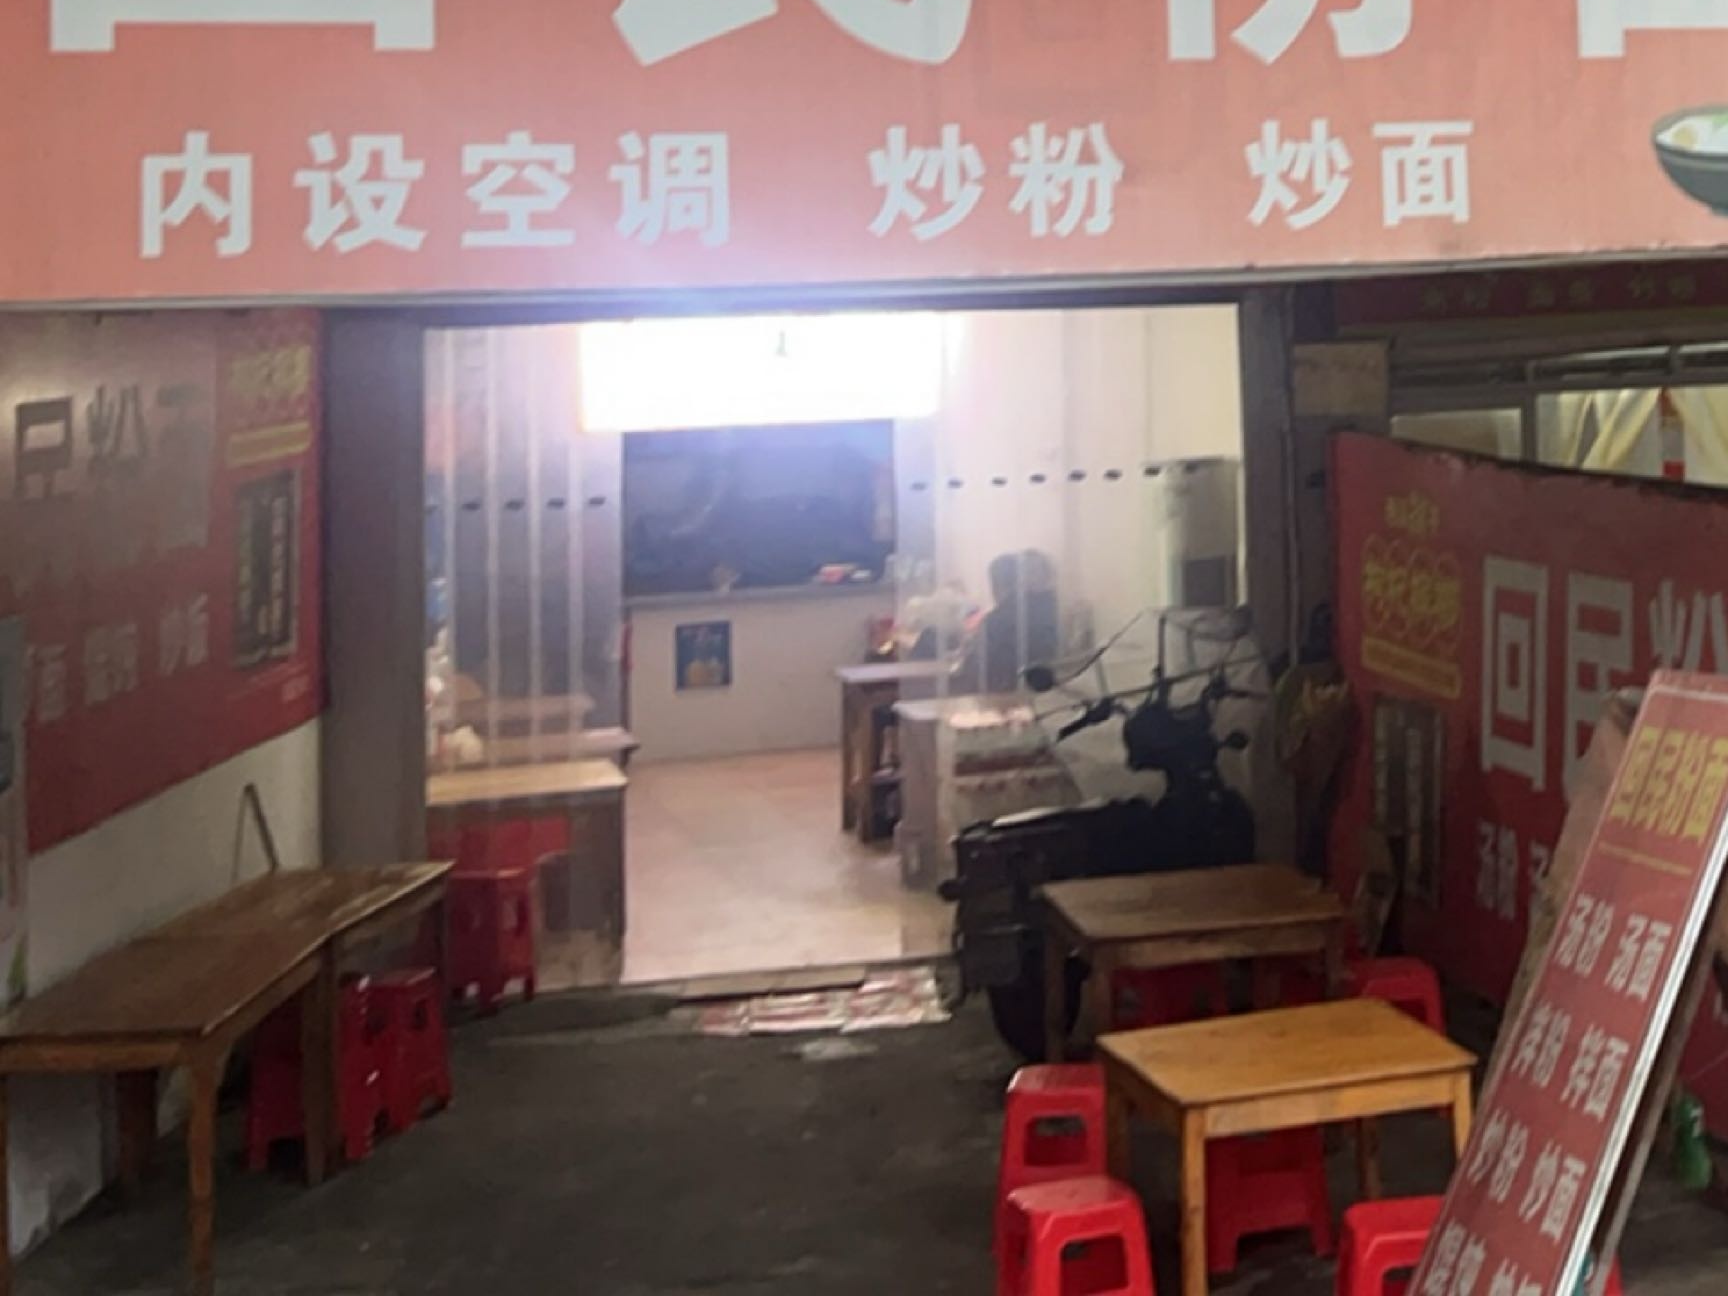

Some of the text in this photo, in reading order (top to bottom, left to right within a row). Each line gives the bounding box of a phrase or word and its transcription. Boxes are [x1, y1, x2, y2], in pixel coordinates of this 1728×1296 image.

[140, 118, 1474, 258] 内设空调 炒粉 炒面
